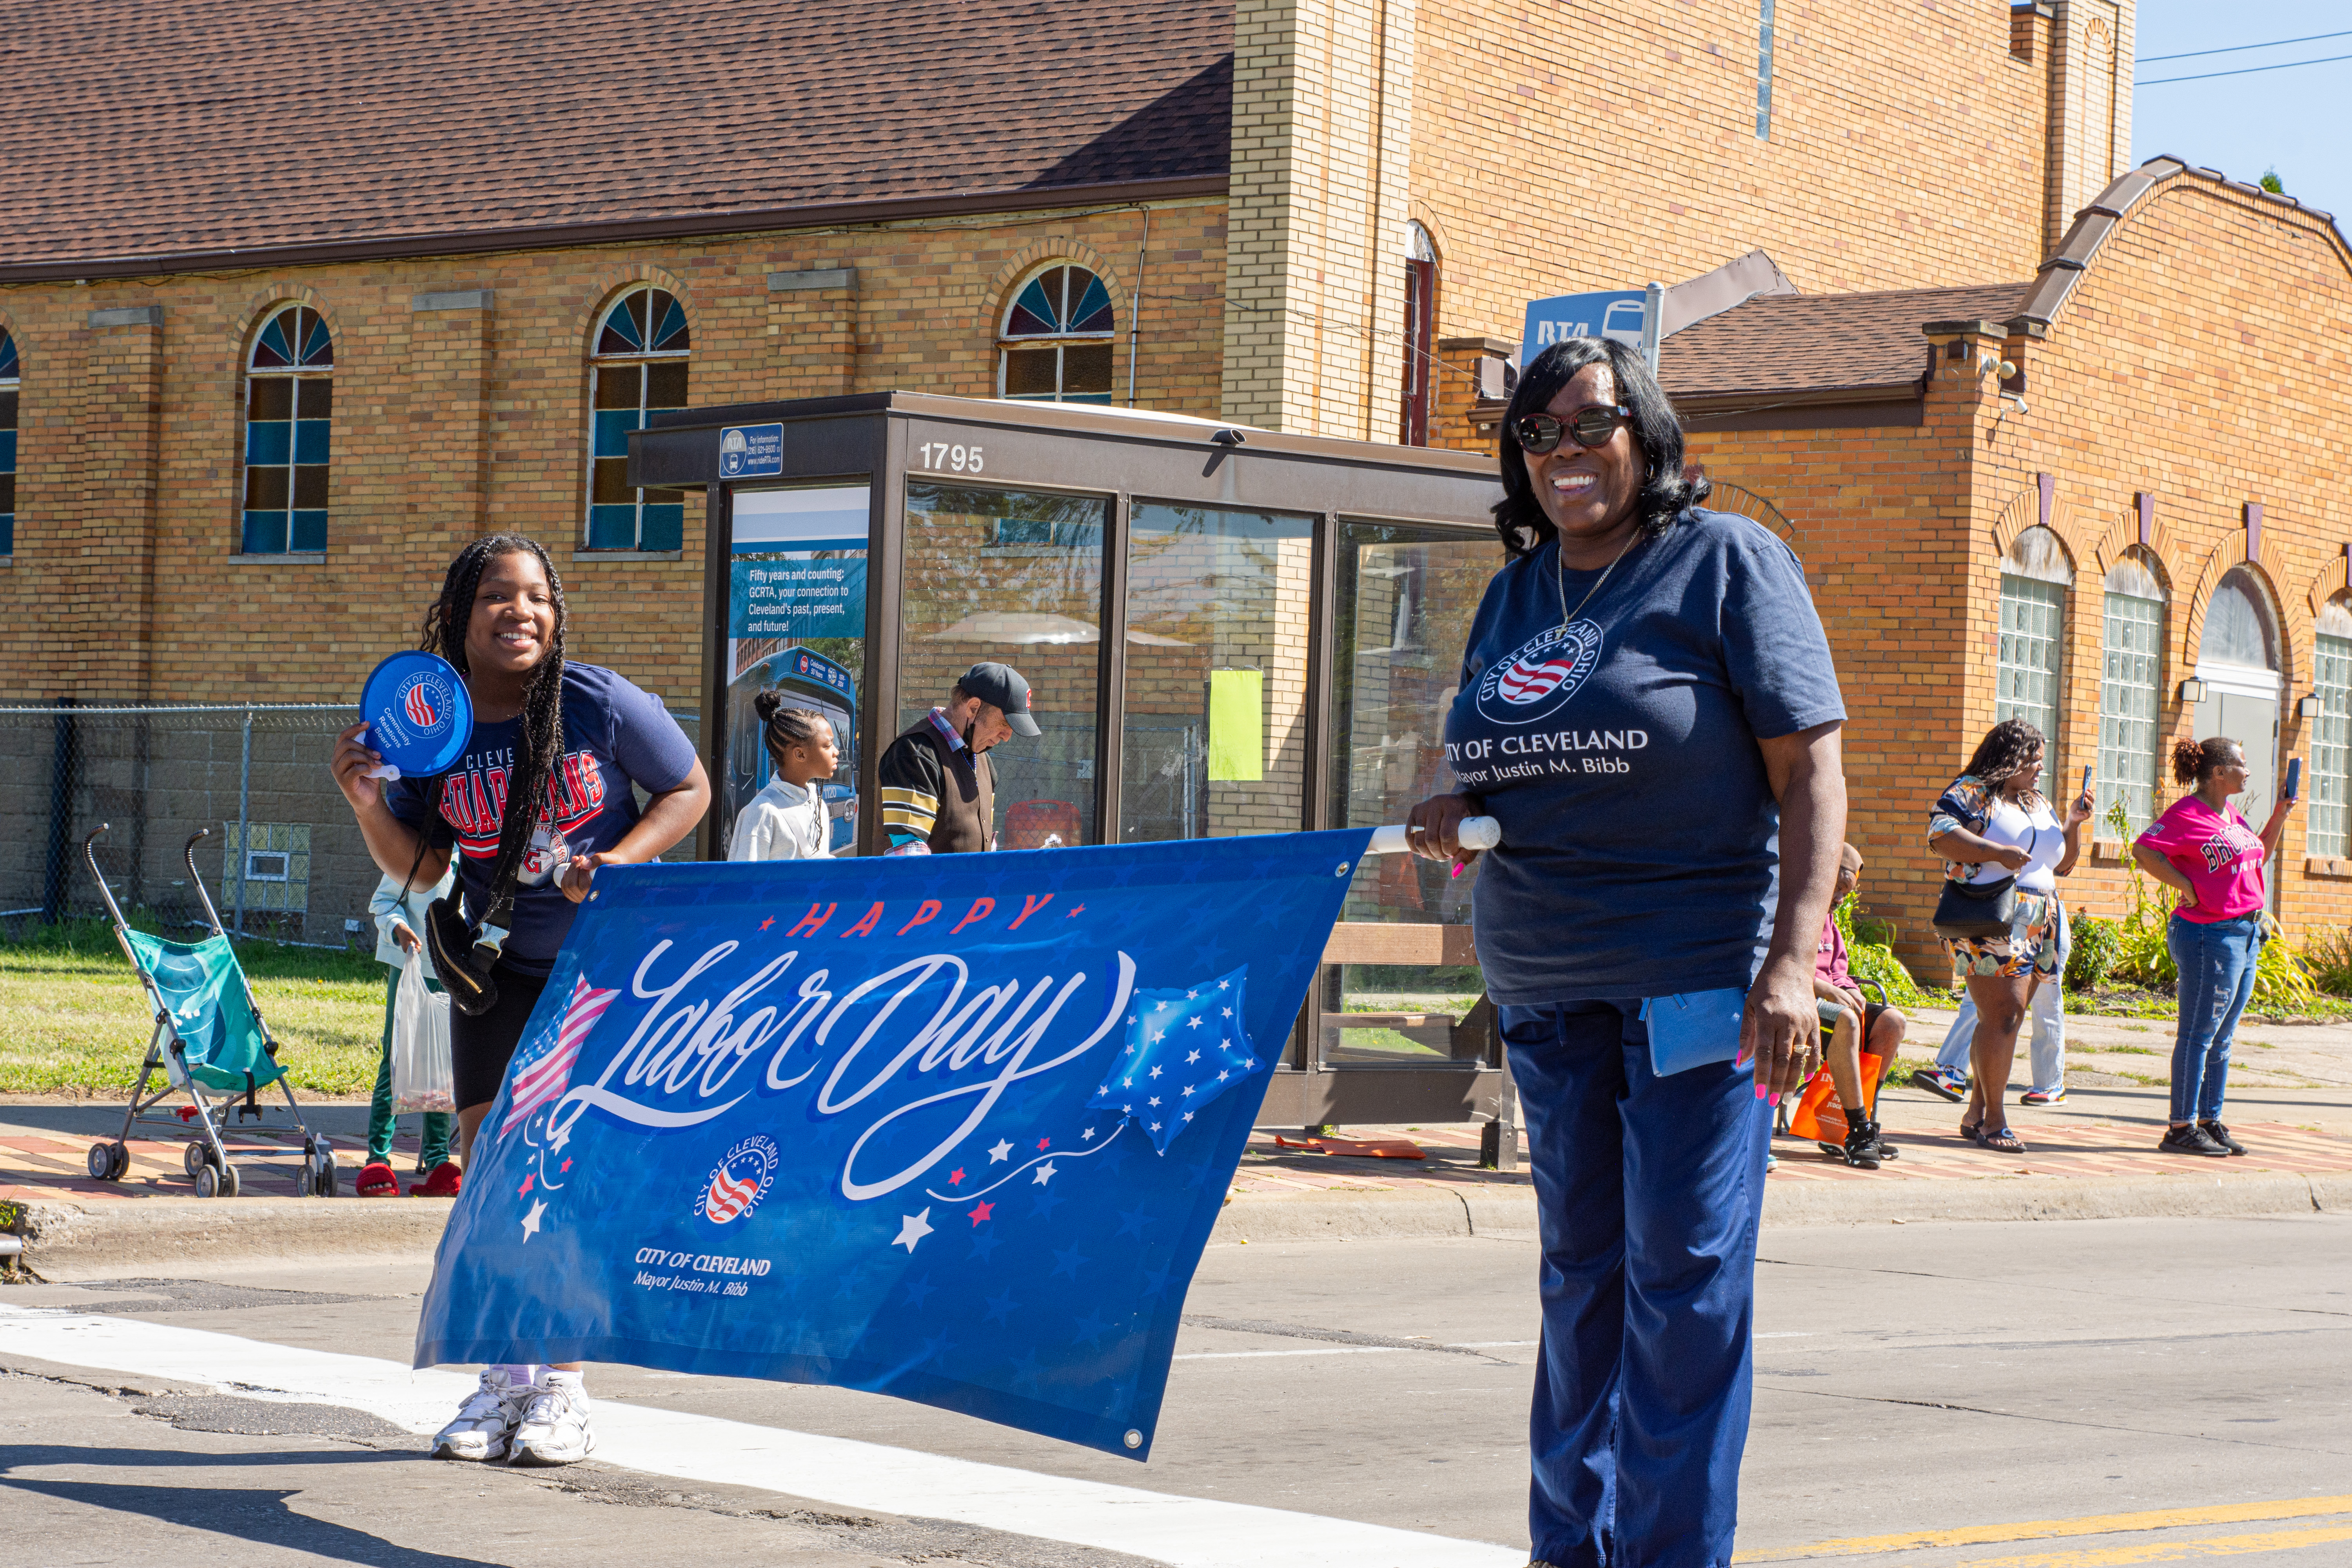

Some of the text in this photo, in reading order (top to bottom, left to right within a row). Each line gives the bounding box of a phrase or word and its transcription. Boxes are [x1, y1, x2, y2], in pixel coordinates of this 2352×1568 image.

[1537, 321, 1588, 346] RTA
[727, 437, 742, 450] RTA
[747, 446, 757, 455] (216)
[758, 445, 775, 454] 621-9500
[757, 435, 779, 443] information:
[748, 456, 780, 465] www.rideRTA.com
[920, 443, 984, 473] 1795
[750, 567, 844, 583] Fifty years and counting:
[749, 585, 848, 600] GCRTA, your connection to
[749, 603, 845, 617] Cleveland's past, present,
[748, 620, 789, 632] and future!
[810, 659, 826, 672] Celebrates
[1481, 624, 1599, 701] CITY OF CLEEAND OHIO
[399, 674, 452, 735] CITY OF CLEVELAND OHIO
[379, 716, 401, 748] Relations
[384, 707, 411, 746] Community
[374, 727, 392, 749] Board
[1445, 730, 1648, 761] ITY OF CLEVELAND
[466, 748, 514, 769] CLEVE
[1492, 761, 1544, 781] Justin
[1549, 759, 1577, 773] M.
[1582, 757, 1630, 773] Bibb
[824, 786, 837, 799] 1120
[2250, 858, 2263, 870] YOR
[786, 893, 1054, 938] HAPPY
[547, 939, 1137, 1201] Labor Day
[1827, 1102, 1842, 1110] JUDGE
[694, 1135, 778, 1218] CITY OF CLEVELAND OHIO
[635, 1247, 771, 1276] CITY OF CLEVELAND
[633, 1270, 748, 1296] Mayor Justin M. Bibb
